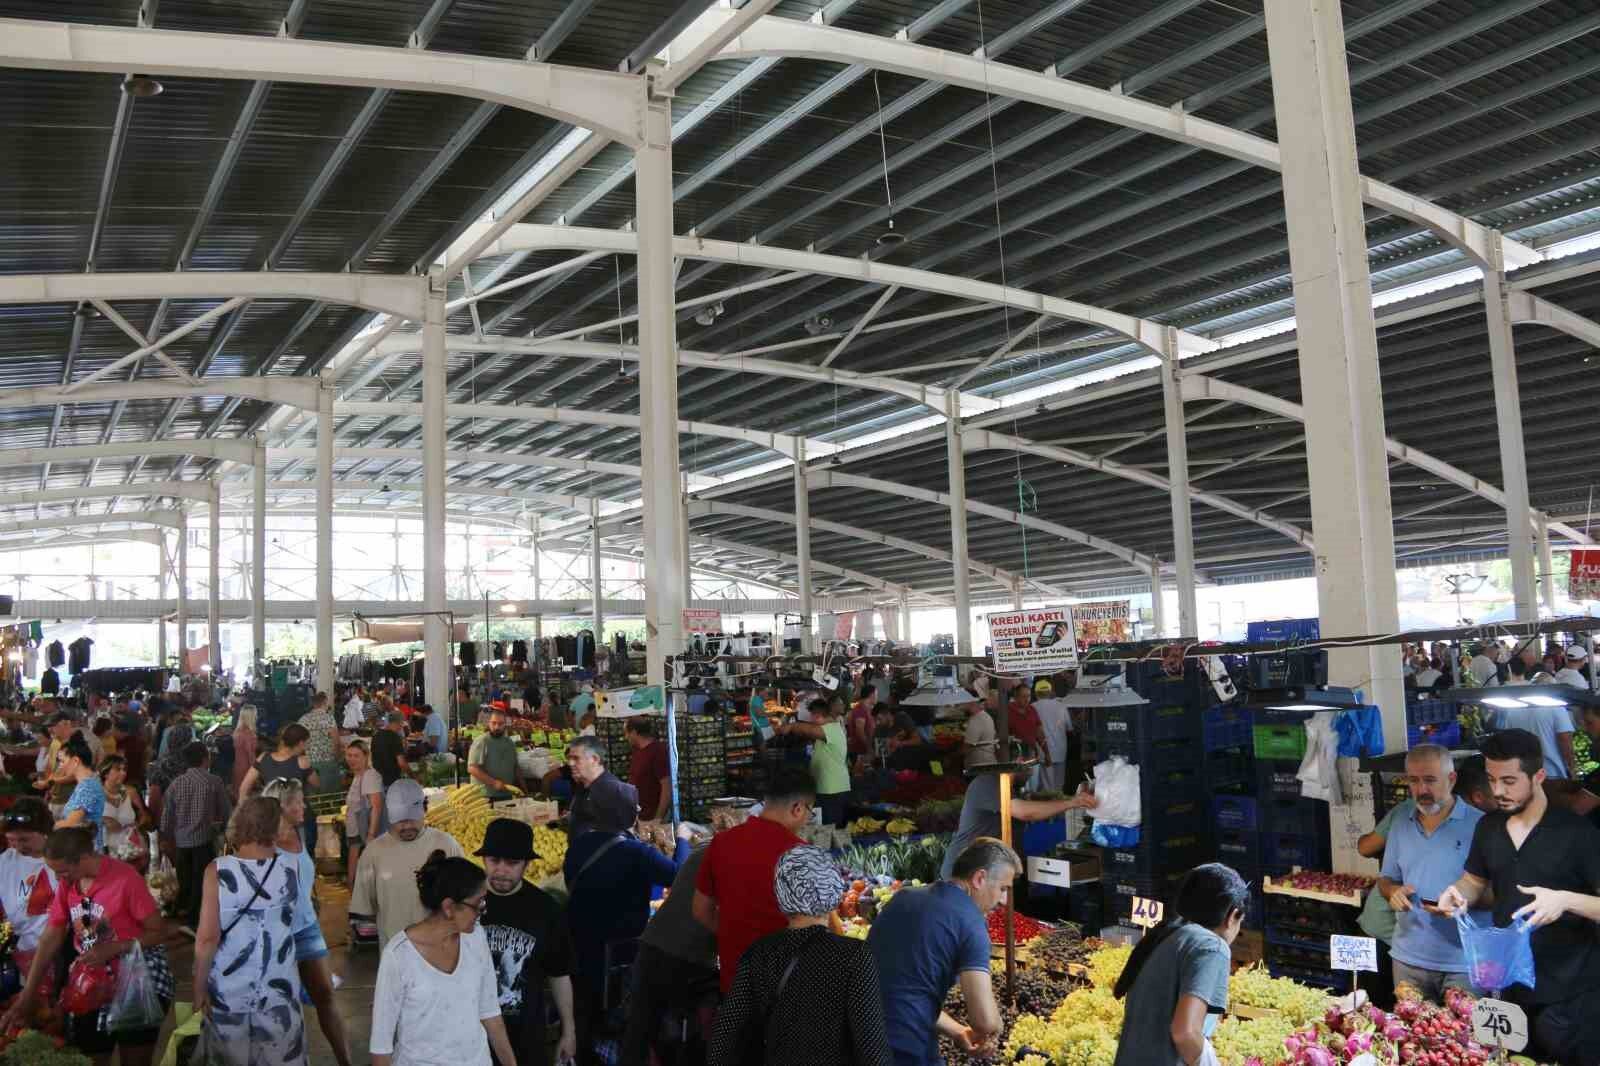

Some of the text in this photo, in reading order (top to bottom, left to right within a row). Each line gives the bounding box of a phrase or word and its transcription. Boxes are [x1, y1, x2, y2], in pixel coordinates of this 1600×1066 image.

[991, 611, 1064, 625] KREDİ KARTI
[998, 649, 1025, 658] Credit
[1027, 648, 1048, 656] Card
[1134, 897, 1159, 919] 40
[1481, 1012, 1513, 1038] 45
